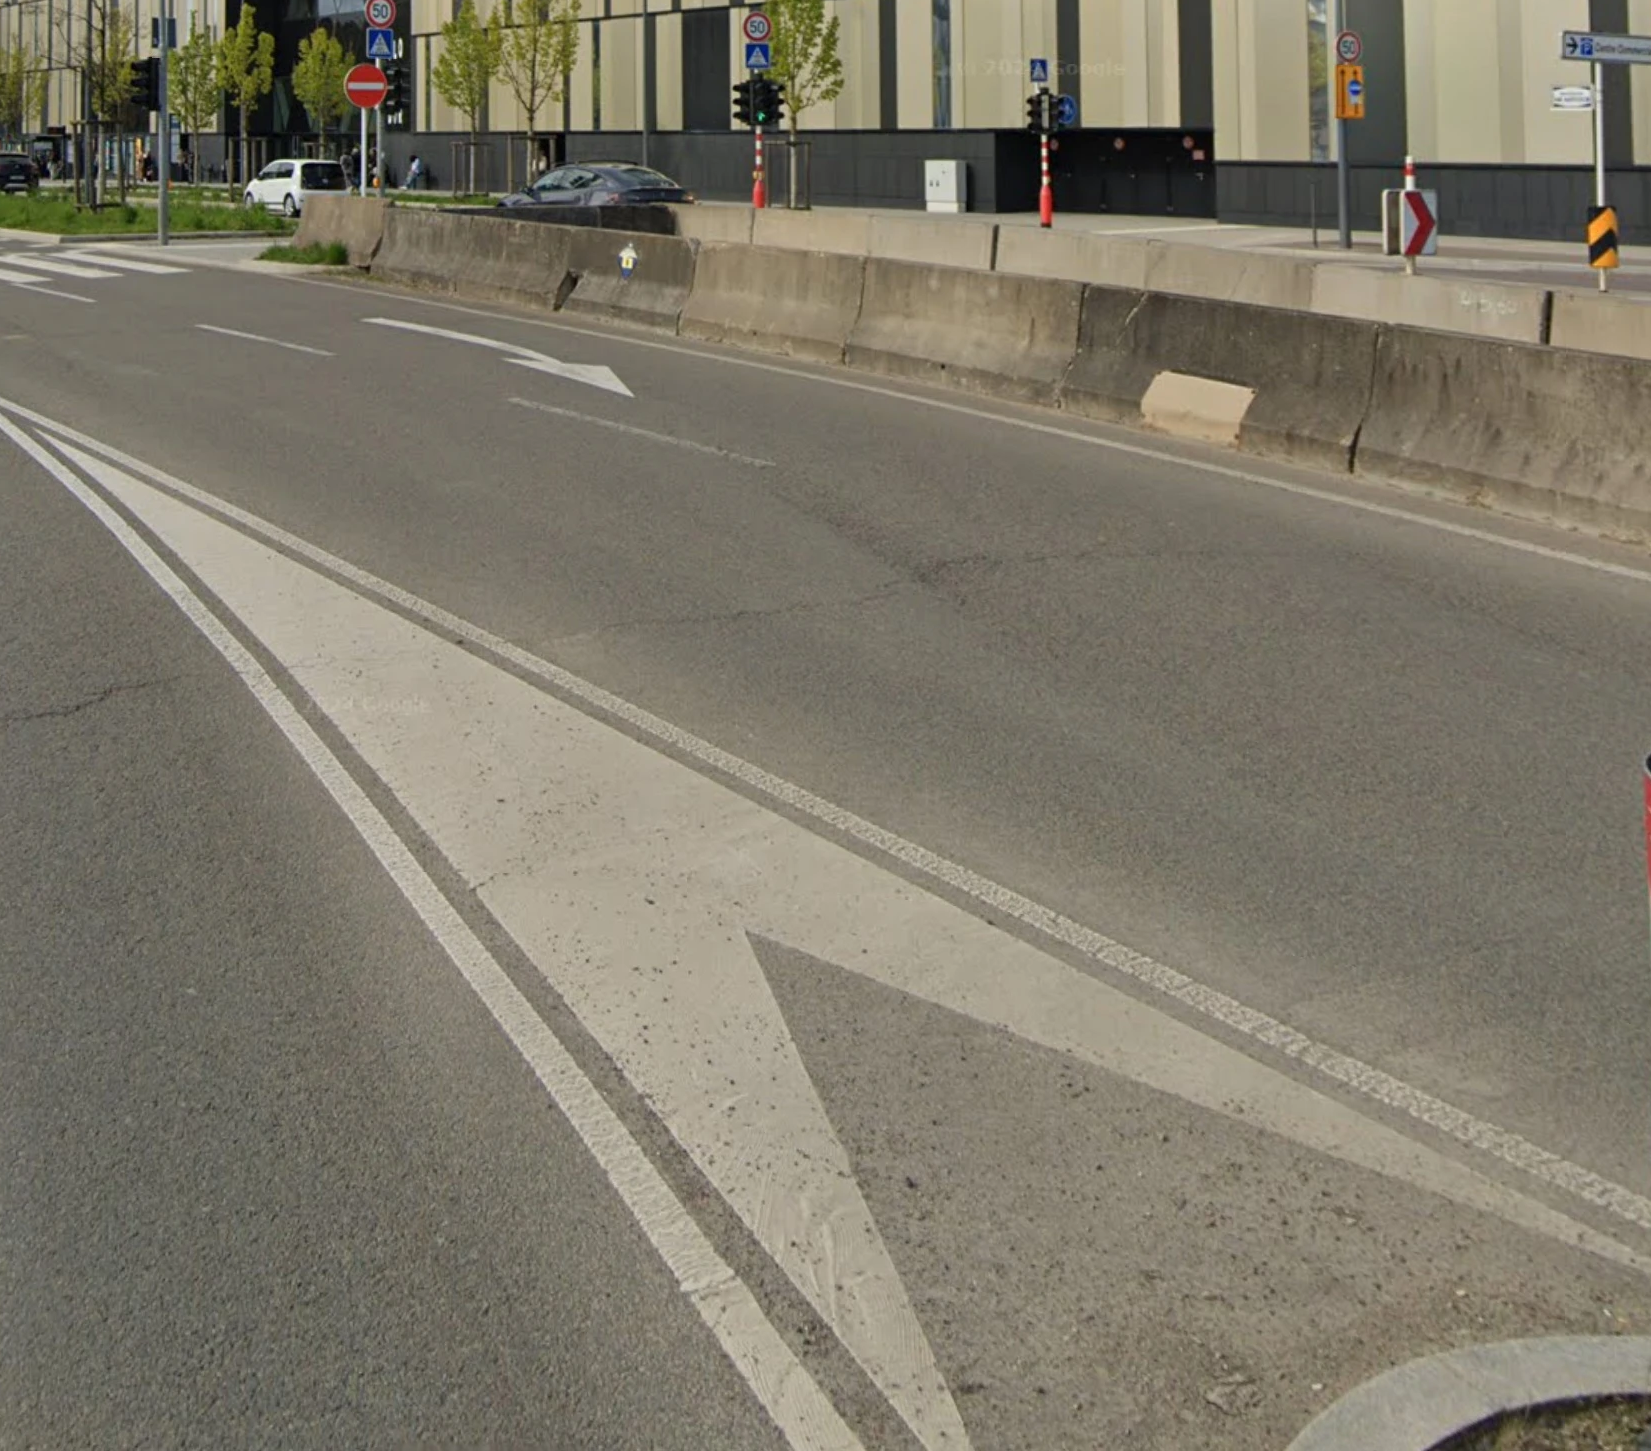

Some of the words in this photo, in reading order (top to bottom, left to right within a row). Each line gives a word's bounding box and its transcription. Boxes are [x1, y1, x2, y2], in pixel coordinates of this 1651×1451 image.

[372, 3, 389, 19] 50
[749, 20, 766, 34] 50
[1341, 39, 1357, 55] 50
